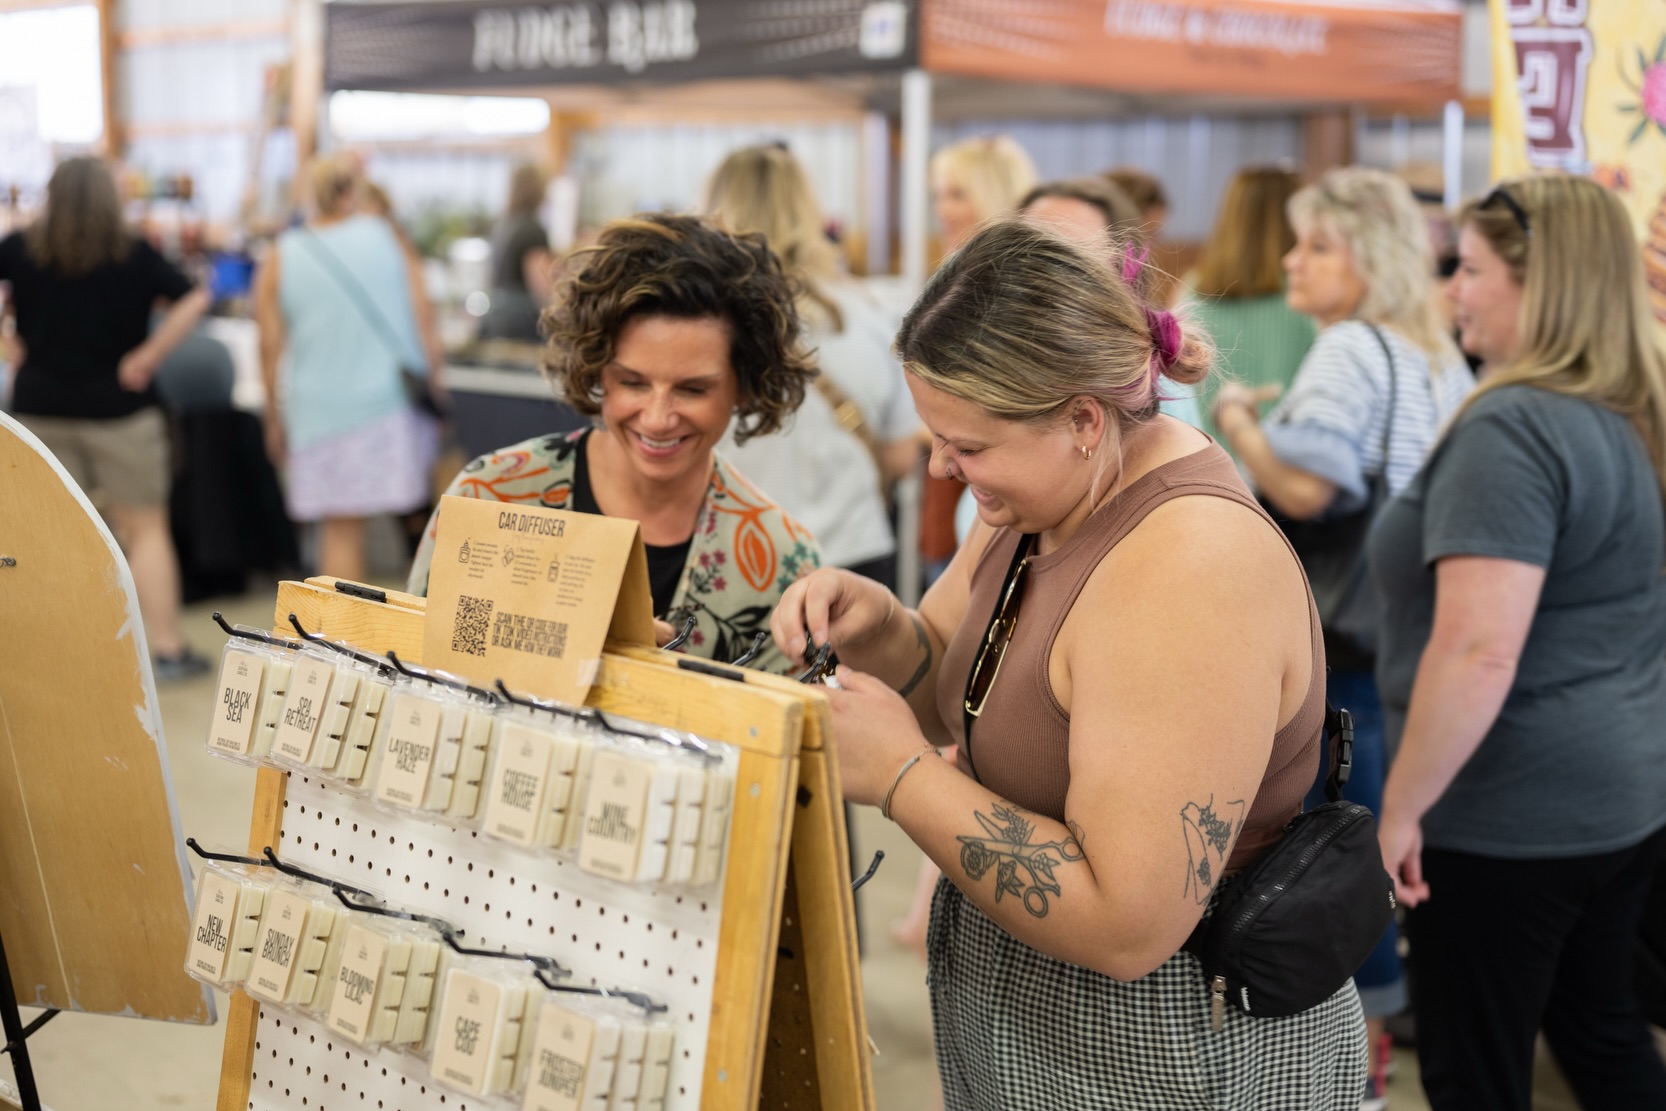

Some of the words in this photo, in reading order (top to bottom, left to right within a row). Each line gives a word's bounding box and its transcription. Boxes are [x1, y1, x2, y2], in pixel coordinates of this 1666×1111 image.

[498, 511, 518, 531] CAR
[518, 514, 566, 538] DIFFUSER
[496, 611, 512, 625] SCAN
[513, 614, 526, 628] THE
[500, 636, 513, 649] ASK
[223, 687, 252, 710] BLACK
[297, 696, 313, 717] SPA
[226, 702, 243, 724] SEA
[284, 708, 317, 734] RETREAT
[388, 737, 430, 763] LAVENDER
[207, 914, 224, 934] NEW
[197, 926, 227, 953] CHAPTER
[265, 928, 295, 953] SUNDAY
[261, 940, 292, 968] BRUNCH
[340, 966, 374, 995] BLOOMING
[344, 982, 366, 1006] LILAC
